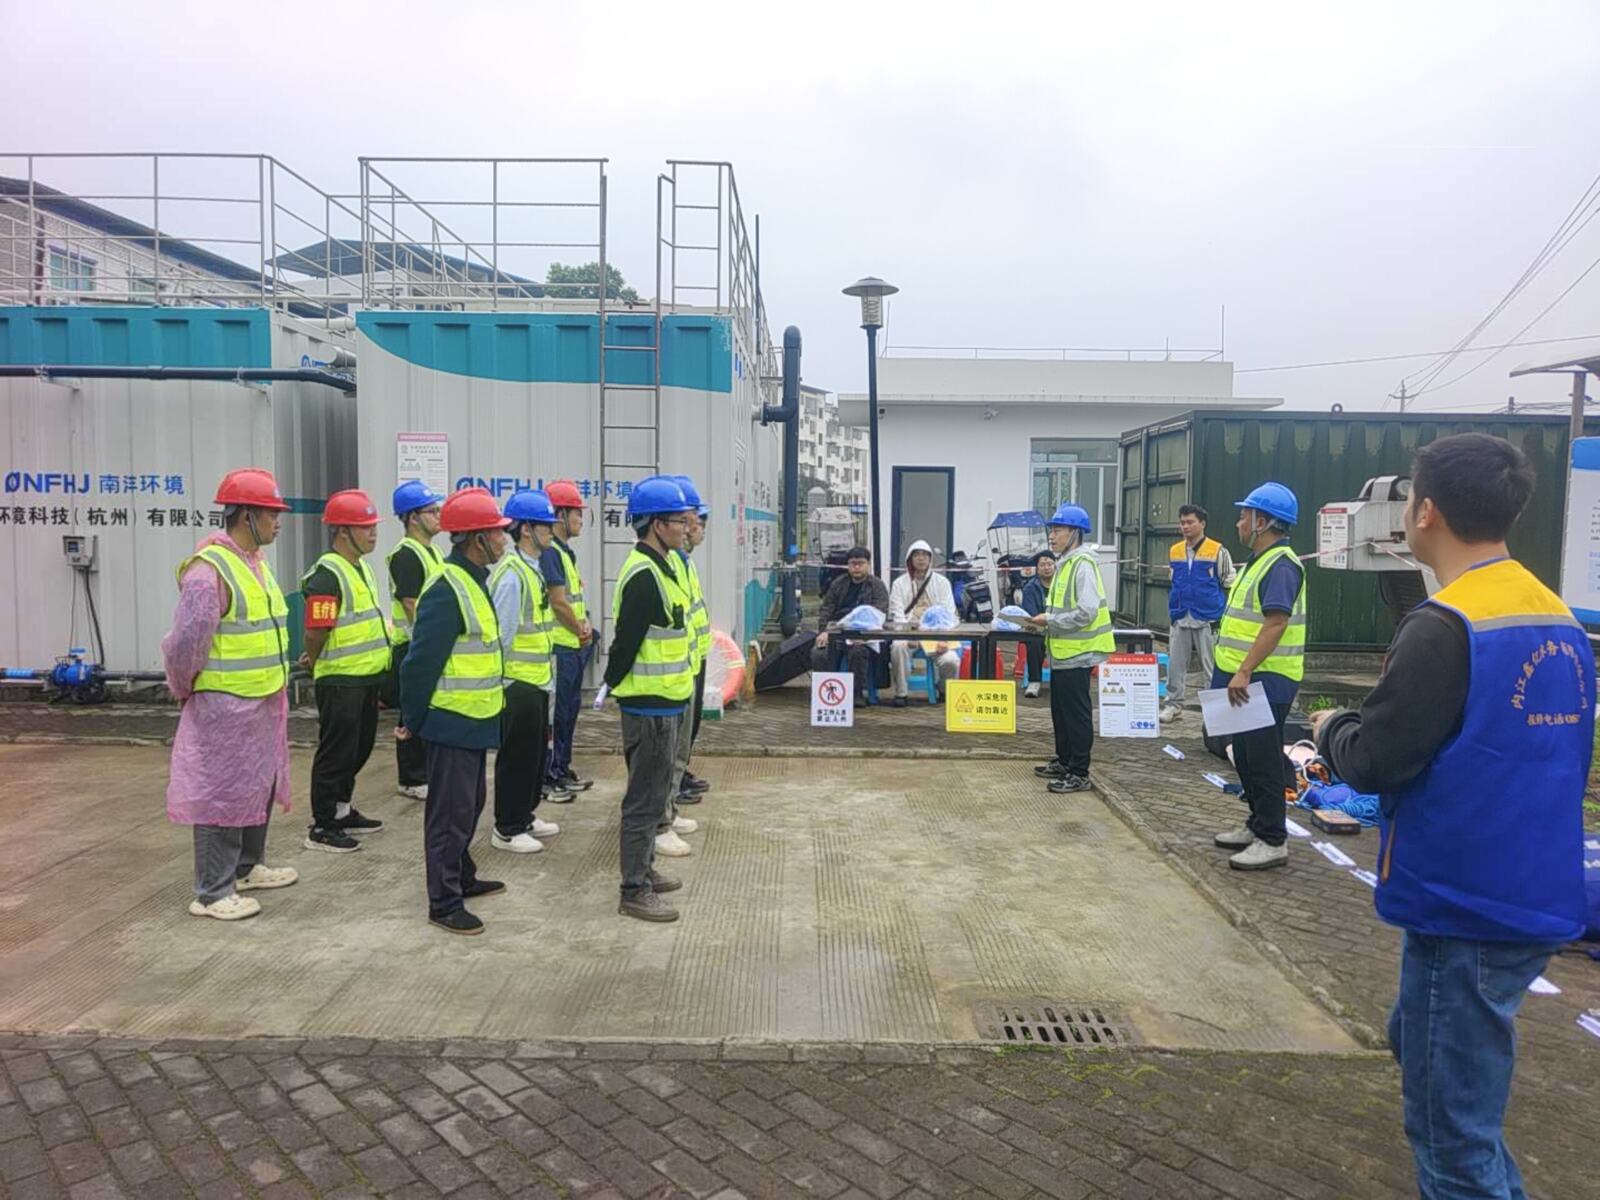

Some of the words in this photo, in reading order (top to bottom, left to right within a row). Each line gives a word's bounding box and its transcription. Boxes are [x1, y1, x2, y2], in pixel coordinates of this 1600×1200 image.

[976, 692, 1009, 702] 水深危险
[976, 705, 1009, 716] 请勿靠近
